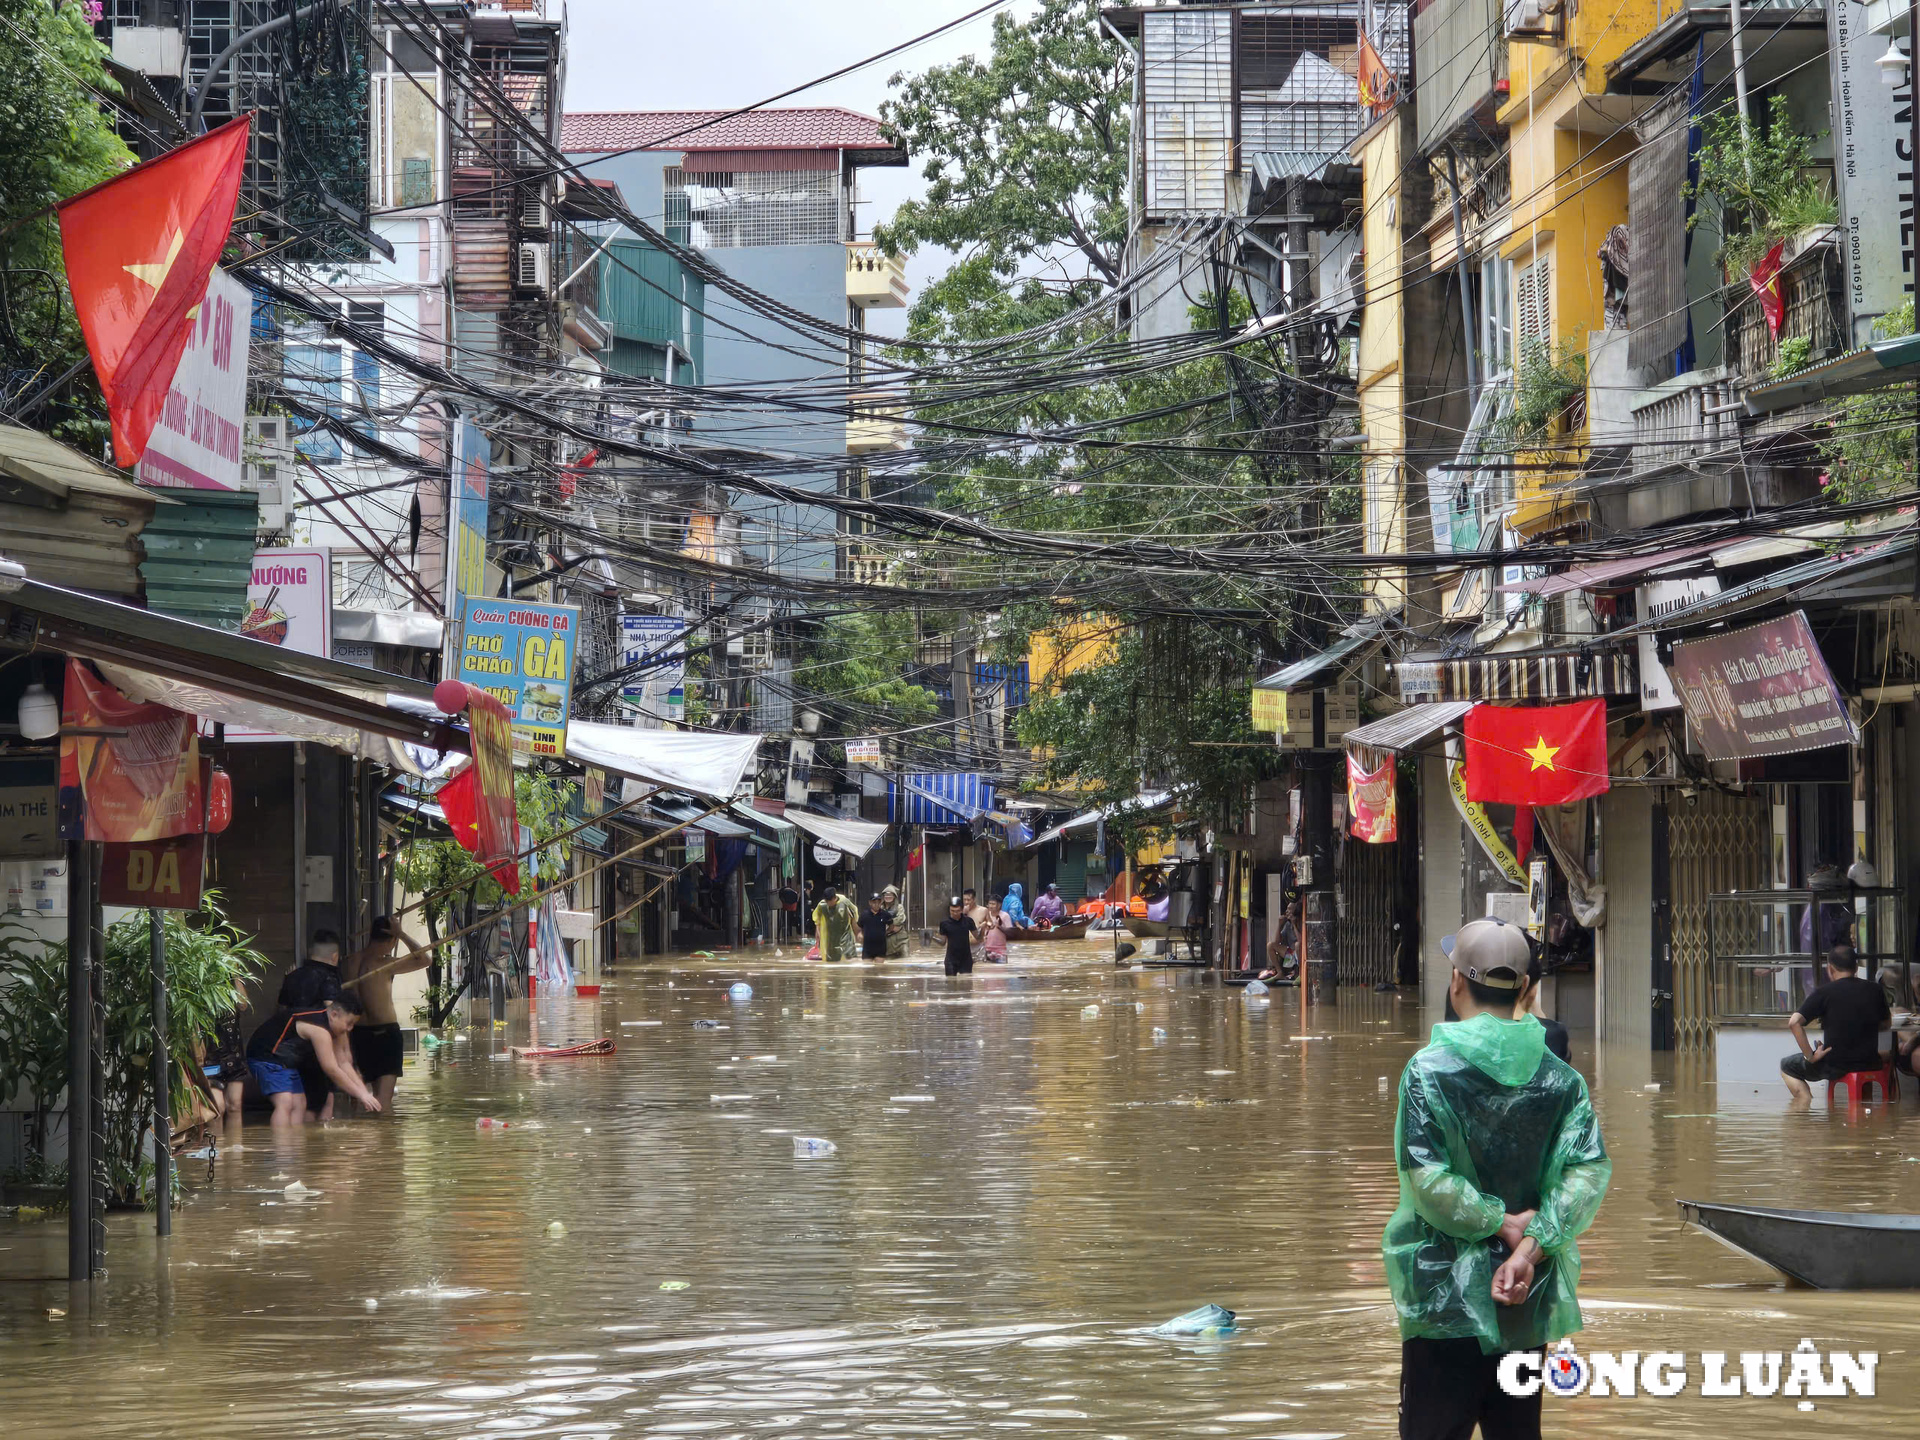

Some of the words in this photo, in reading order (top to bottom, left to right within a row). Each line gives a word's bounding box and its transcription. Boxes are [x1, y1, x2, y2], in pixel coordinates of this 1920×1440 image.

[1839, 14, 1847, 26] 18
[1840, 50, 1850, 72] Linh
[1842, 81, 1851, 108] Hoàn
[1844, 110, 1855, 136] Kiếm
[1846, 144, 1855, 158] Hà
[1845, 160, 1857, 178] Nội
[1850, 216, 1859, 234] ĐT:
[1851, 236, 1861, 261] 0903
[1852, 263, 1862, 283] 416
[1853, 284, 1863, 304] 912
[212, 293, 234, 373] BIN
[249, 564, 307, 586] NƯỚNG
[472, 608, 506, 624] Quán
[552, 614, 569, 631] GÀ
[465, 634, 504, 654] PHỞ
[630, 631, 647, 642] NHÀ
[464, 654, 513, 675] CHÁO
[523, 631, 567, 680] GÀ
[533, 732, 556, 743] LINH
[533, 743, 557, 754] 980
[19, 797, 48, 817] THẺ
[1452, 780, 1462, 794] 28
[1473, 816, 1491, 840] LINH
[1496, 850, 1510, 867] ĐT:
